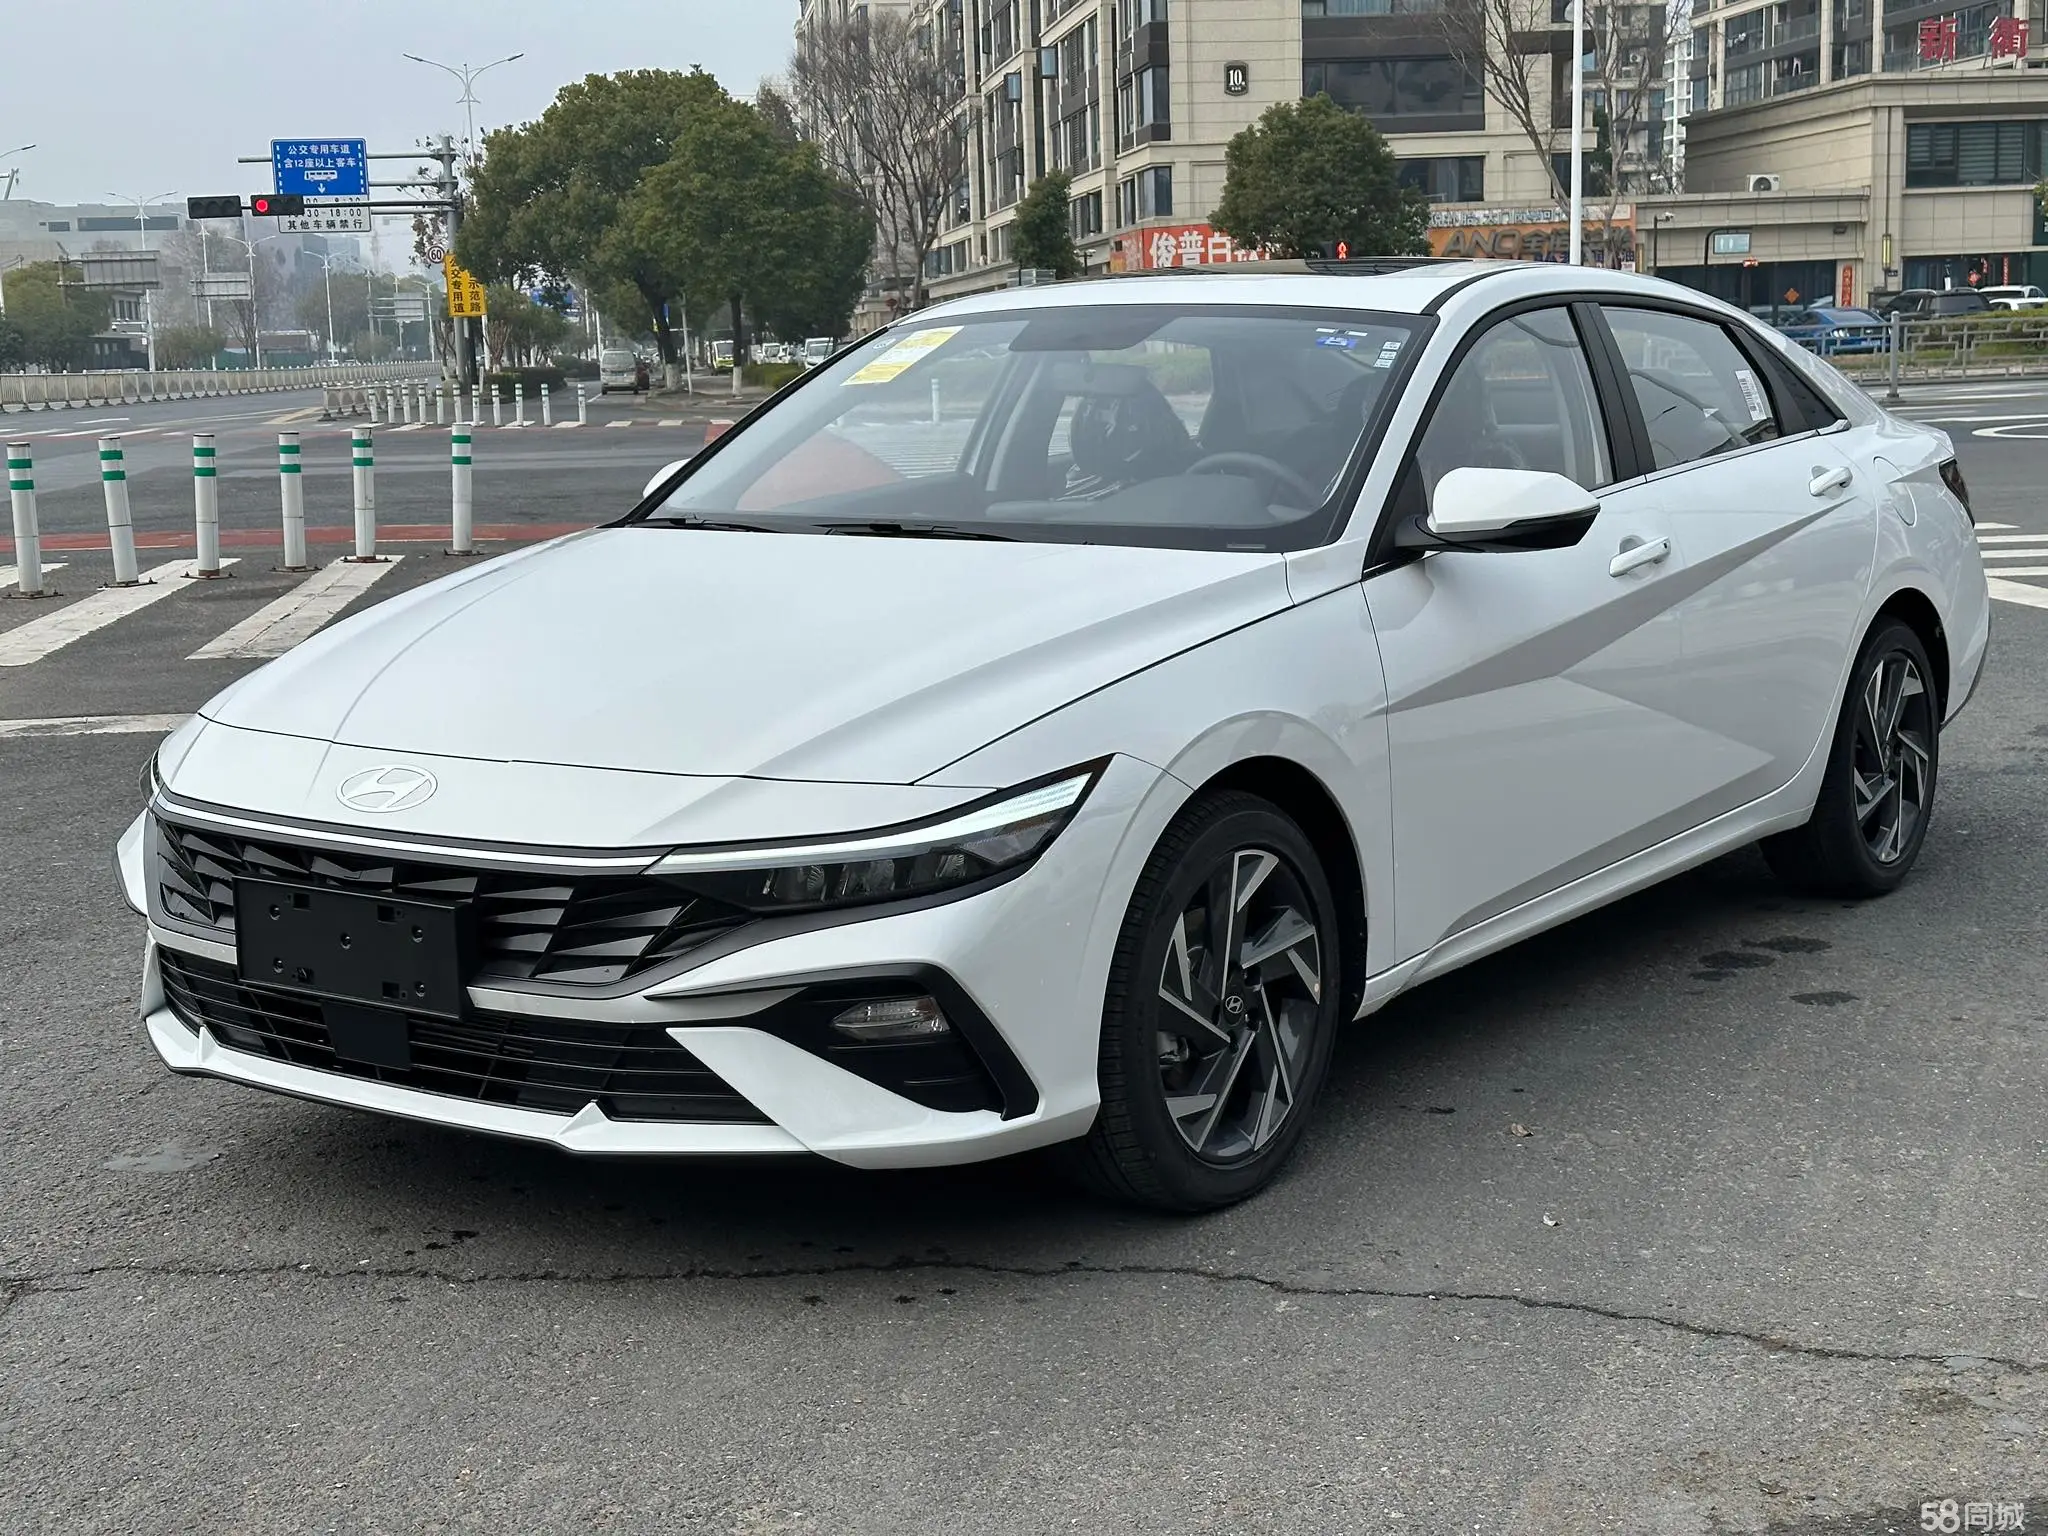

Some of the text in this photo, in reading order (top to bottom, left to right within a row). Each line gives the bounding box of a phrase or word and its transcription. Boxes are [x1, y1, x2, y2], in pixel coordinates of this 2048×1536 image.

[288, 144, 351, 154] 公交专用车道
[283, 157, 357, 168] 含12座以上客车
[288, 219, 362, 230] 其他车辆禁行
[431, 249, 442, 260] 60
